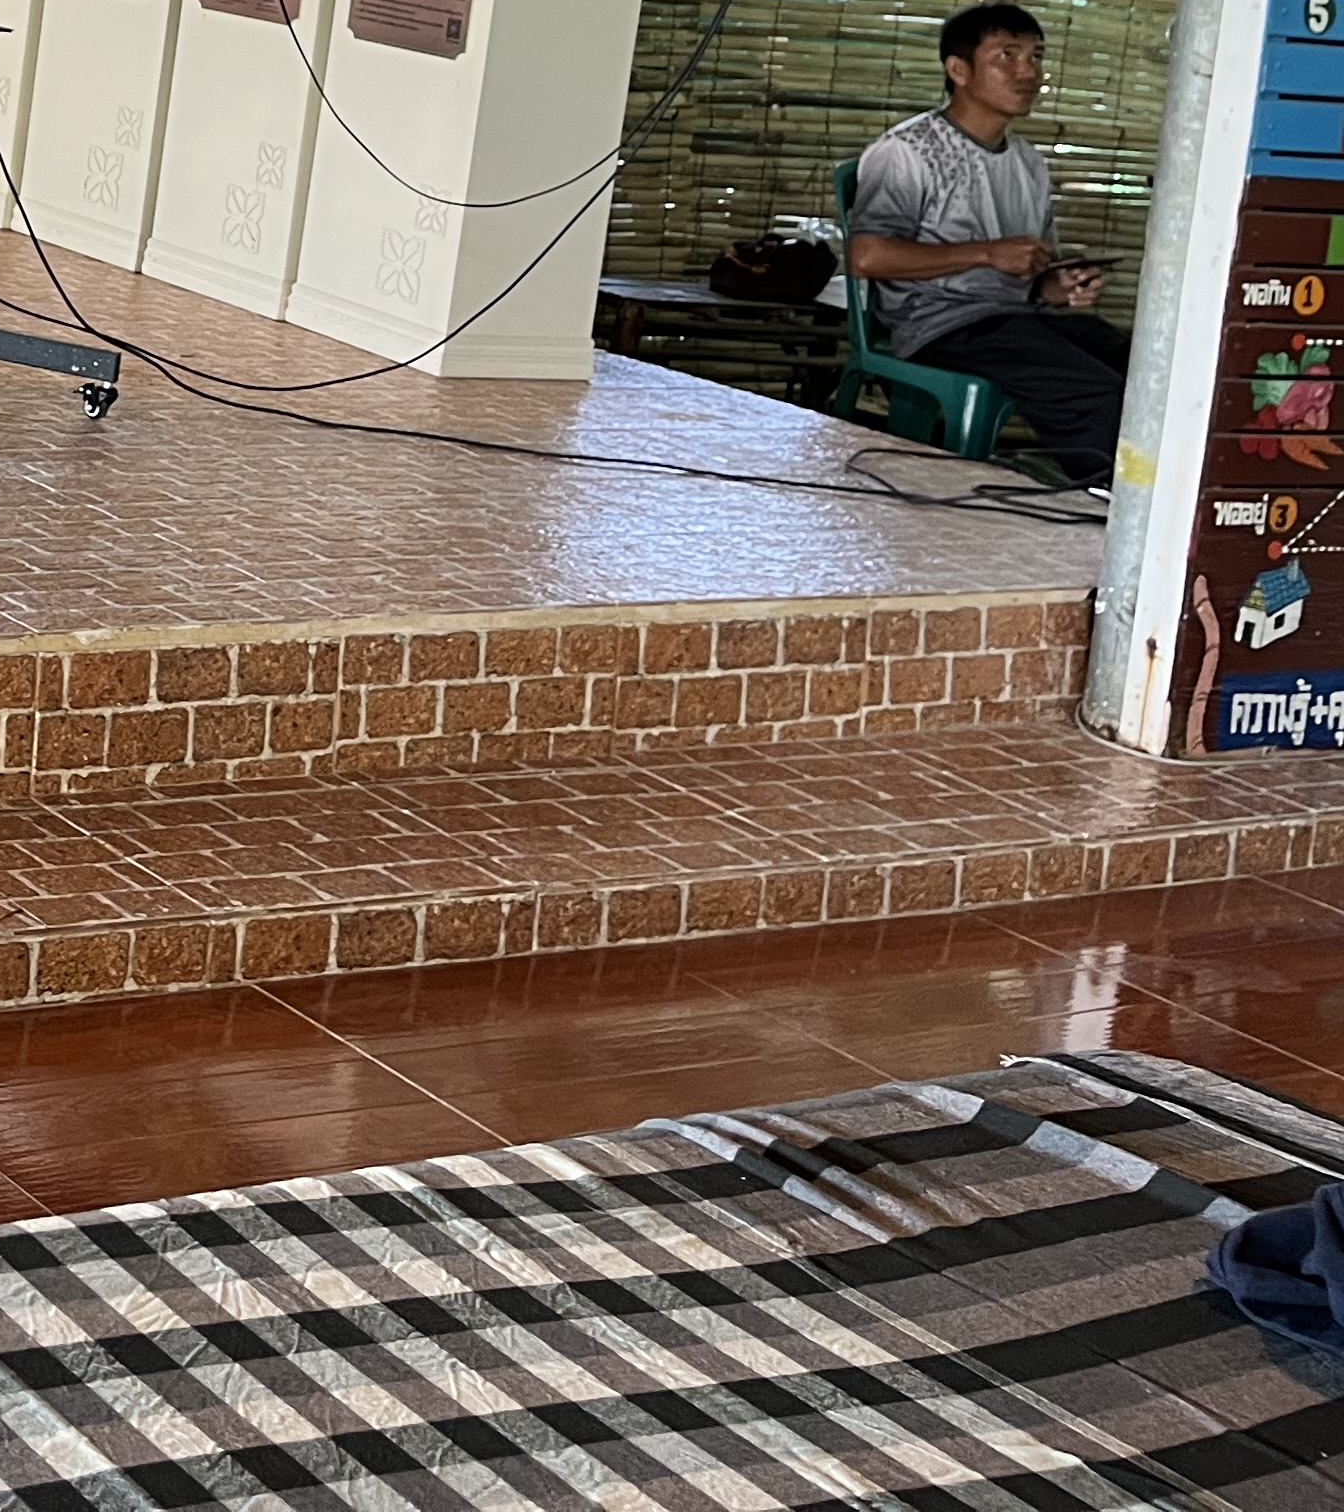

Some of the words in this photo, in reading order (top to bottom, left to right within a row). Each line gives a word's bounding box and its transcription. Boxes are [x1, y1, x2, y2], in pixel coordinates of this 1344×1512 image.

[1241, 278, 1292, 306] พอกิน
[1302, 279, 1313, 307] 1
[1213, 493, 1269, 536] พออยู่
[1275, 504, 1289, 528] 3
